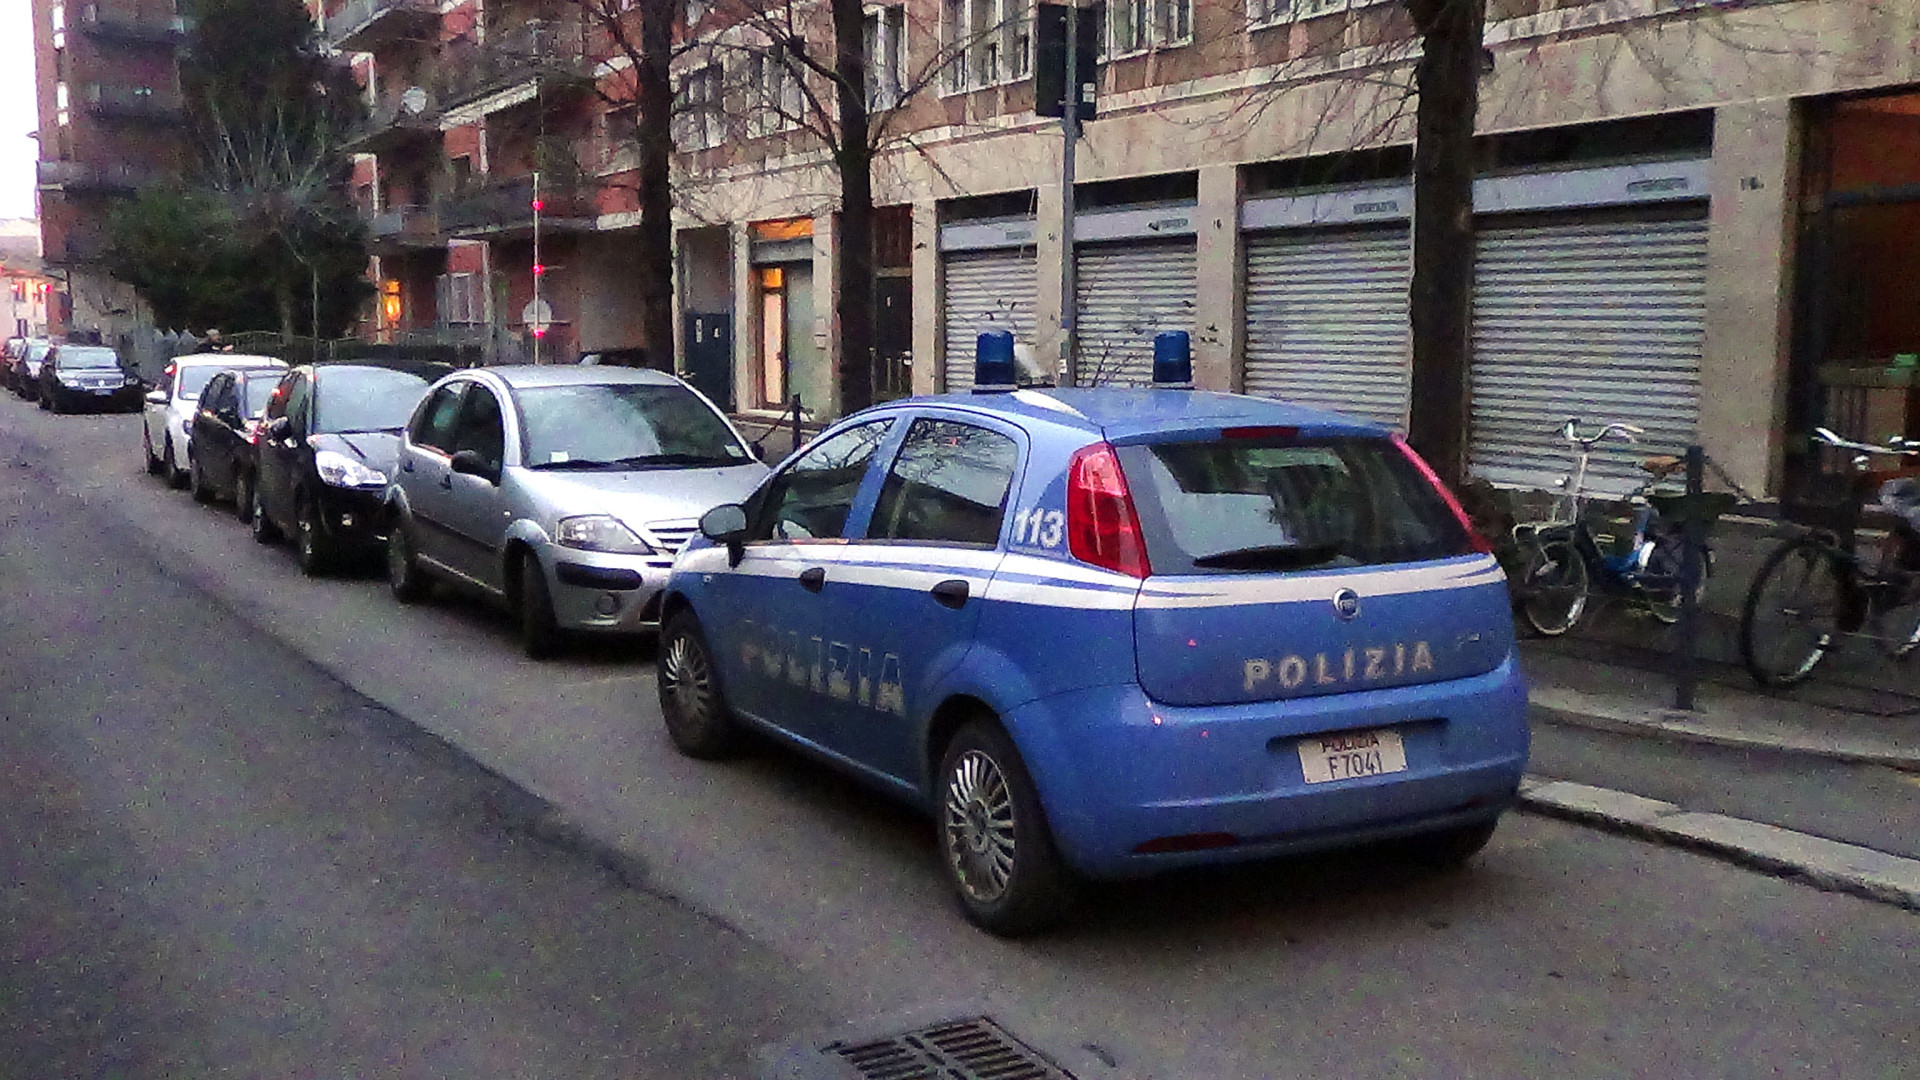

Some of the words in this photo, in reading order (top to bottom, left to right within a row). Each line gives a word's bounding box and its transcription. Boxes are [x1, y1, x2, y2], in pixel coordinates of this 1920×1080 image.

[1015, 507, 1064, 547] 113
[1244, 641, 1433, 692] POLIZIA
[1329, 751, 1383, 780] F7041
